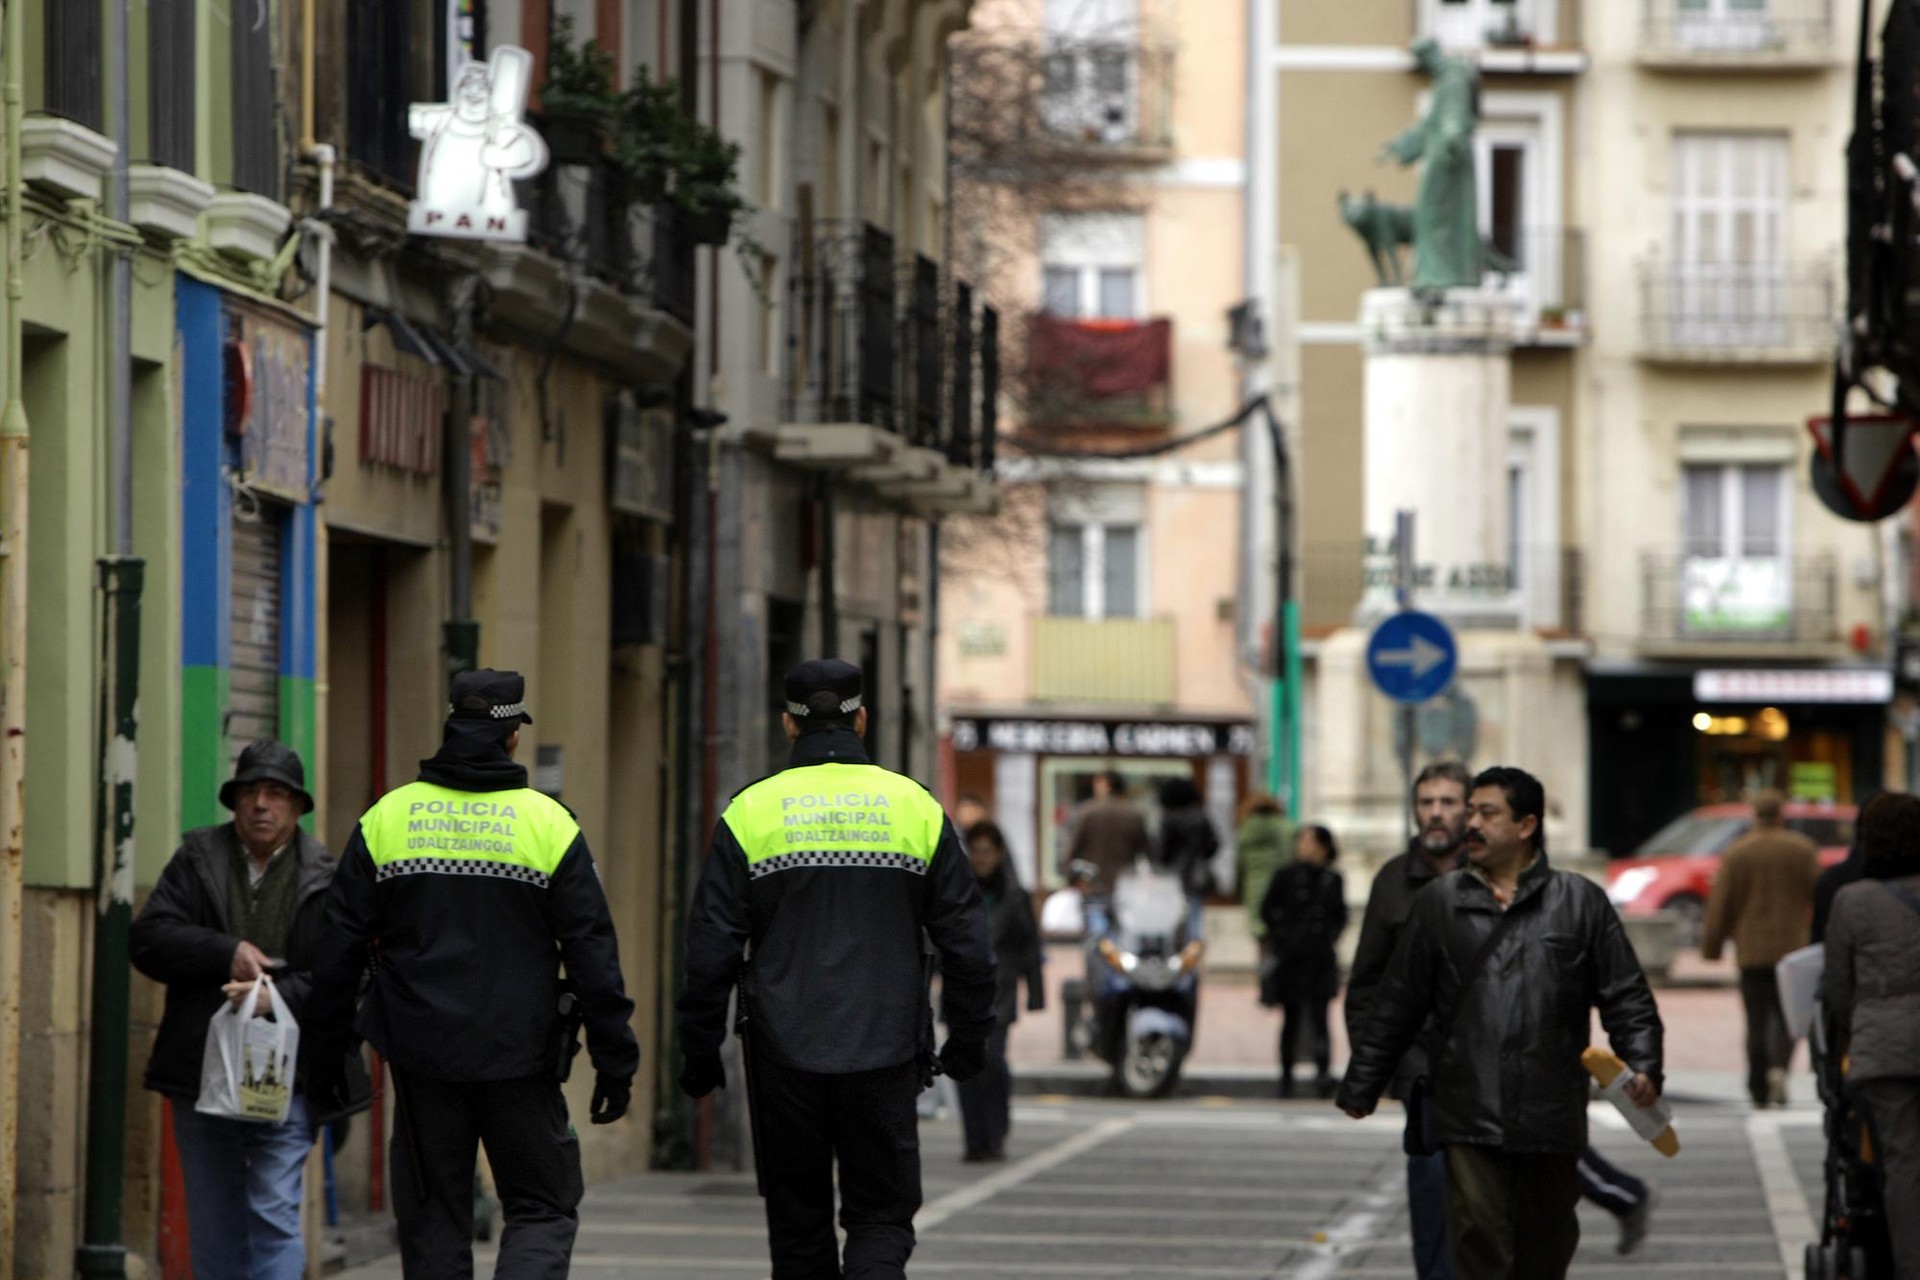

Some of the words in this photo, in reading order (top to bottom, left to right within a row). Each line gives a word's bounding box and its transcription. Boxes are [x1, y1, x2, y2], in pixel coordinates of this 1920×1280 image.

[425, 210, 506, 231] PAN
[409, 800, 517, 819] POLICIA
[782, 793, 891, 811] POLICIA
[783, 810, 892, 826] MUNICIPAL
[407, 818, 516, 837] MUNICIPAL
[785, 828, 891, 843] UDALTZAINGOA
[406, 836, 514, 854] UDALTZAINGOA
